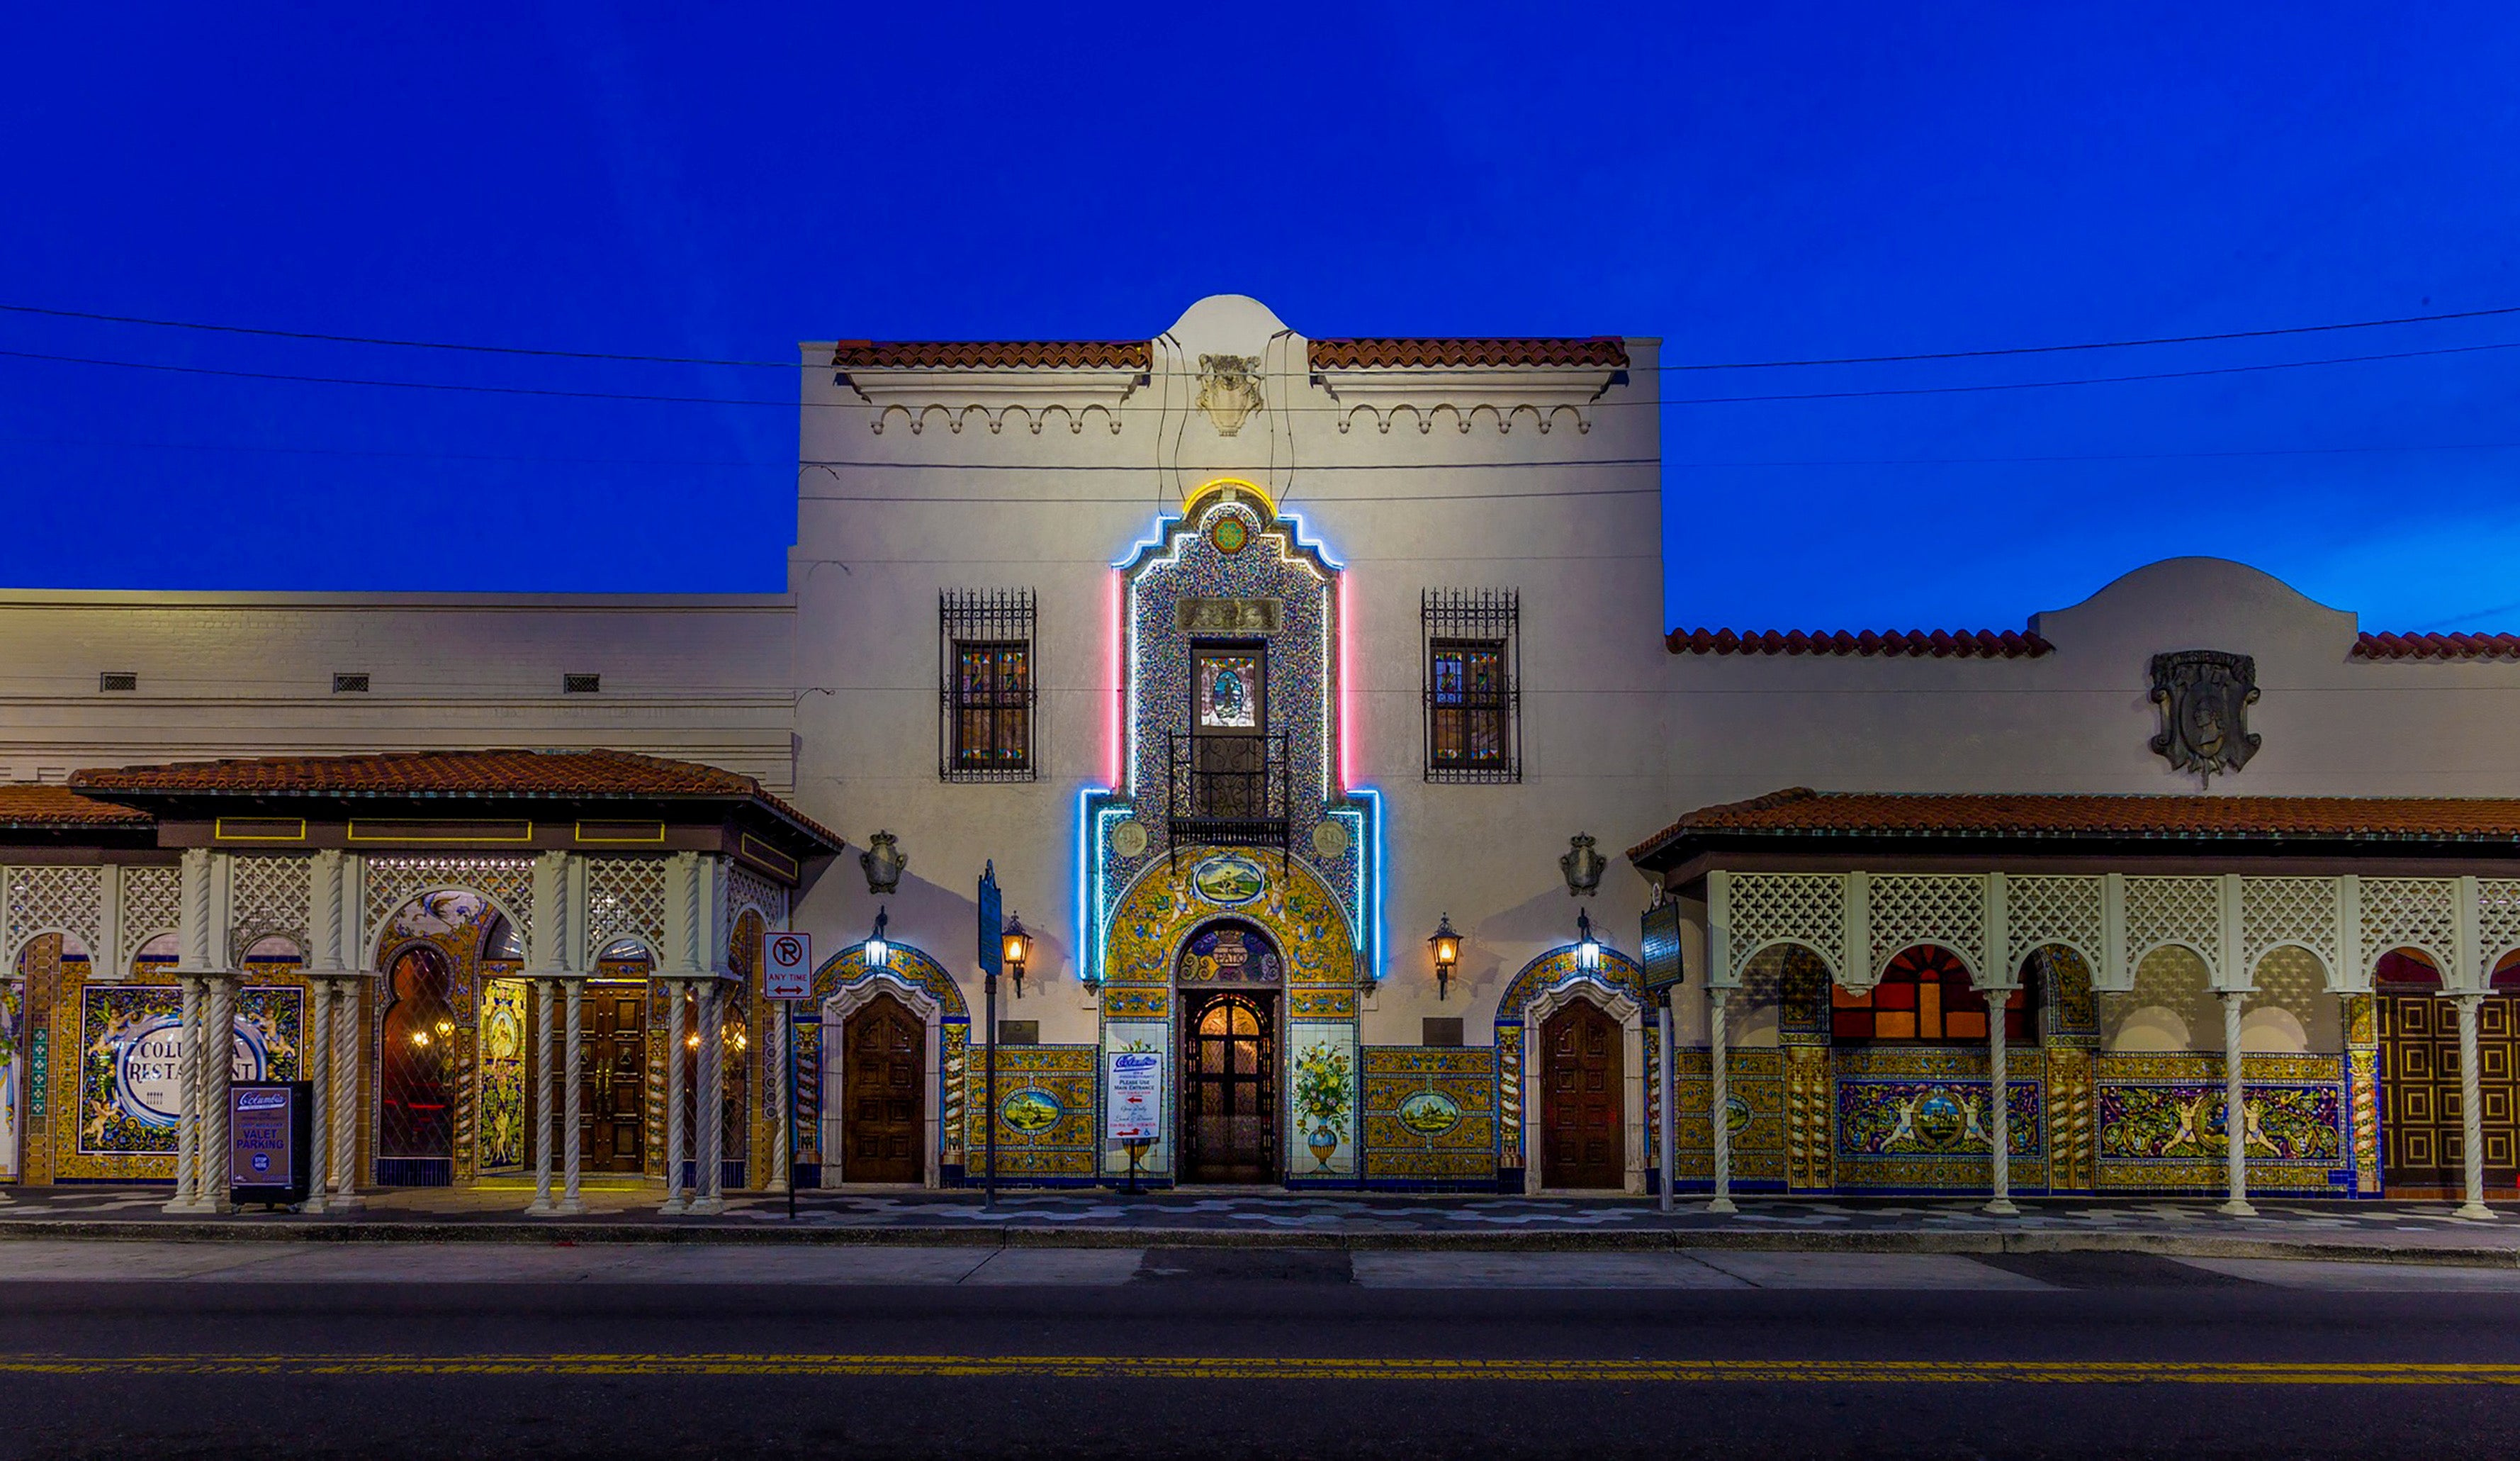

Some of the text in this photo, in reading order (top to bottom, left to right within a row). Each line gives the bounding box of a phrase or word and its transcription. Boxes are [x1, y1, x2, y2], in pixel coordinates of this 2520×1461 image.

[1217, 953, 1245, 963] PATIO
[239, 1091, 286, 1106] Columbia
[243, 1129, 278, 1139] VALET
[236, 1138, 285, 1149] PARKING
